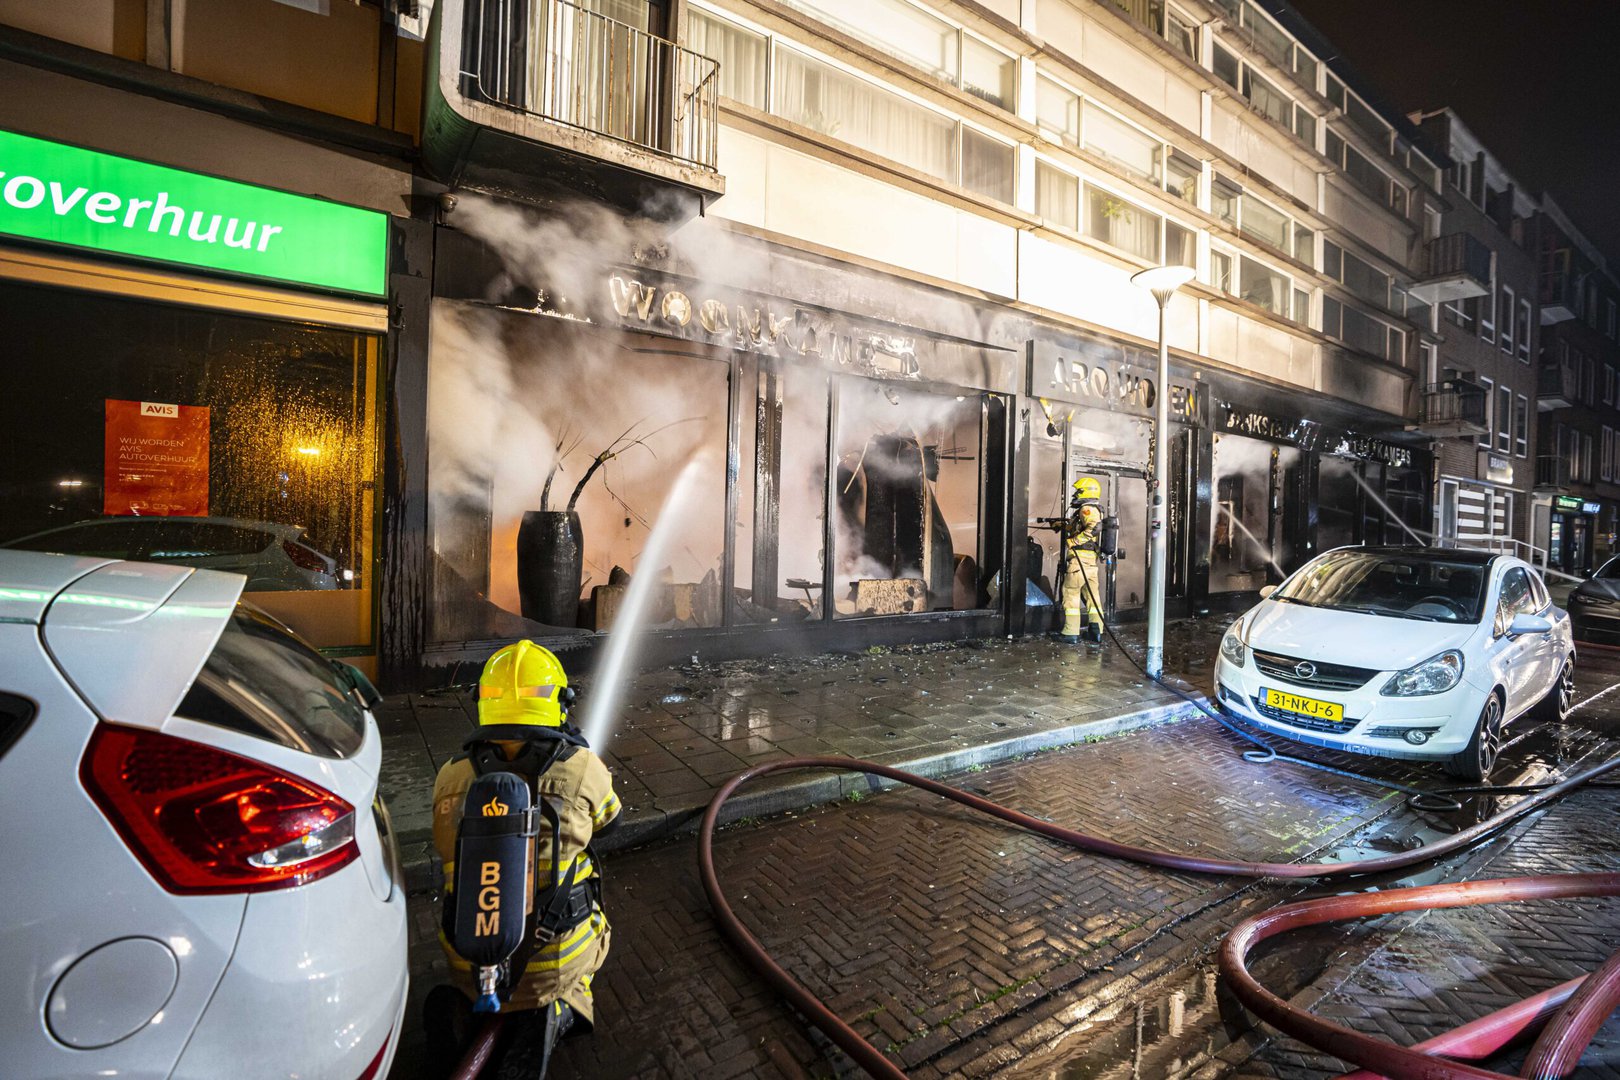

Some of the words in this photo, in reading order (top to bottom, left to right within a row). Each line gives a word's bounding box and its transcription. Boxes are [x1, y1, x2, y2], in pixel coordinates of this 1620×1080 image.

[0, 171, 283, 253] overhuur
[146, 405, 173, 415] AVIS
[120, 437, 137, 445] WIJ
[140, 438, 185, 448] WORDEN
[120, 445, 142, 453] AVIS
[120, 453, 196, 463] AUTOVERHUUR
[1272, 693, 1334, 717] 31-NKJ-6
[474, 861, 501, 937] BGM
